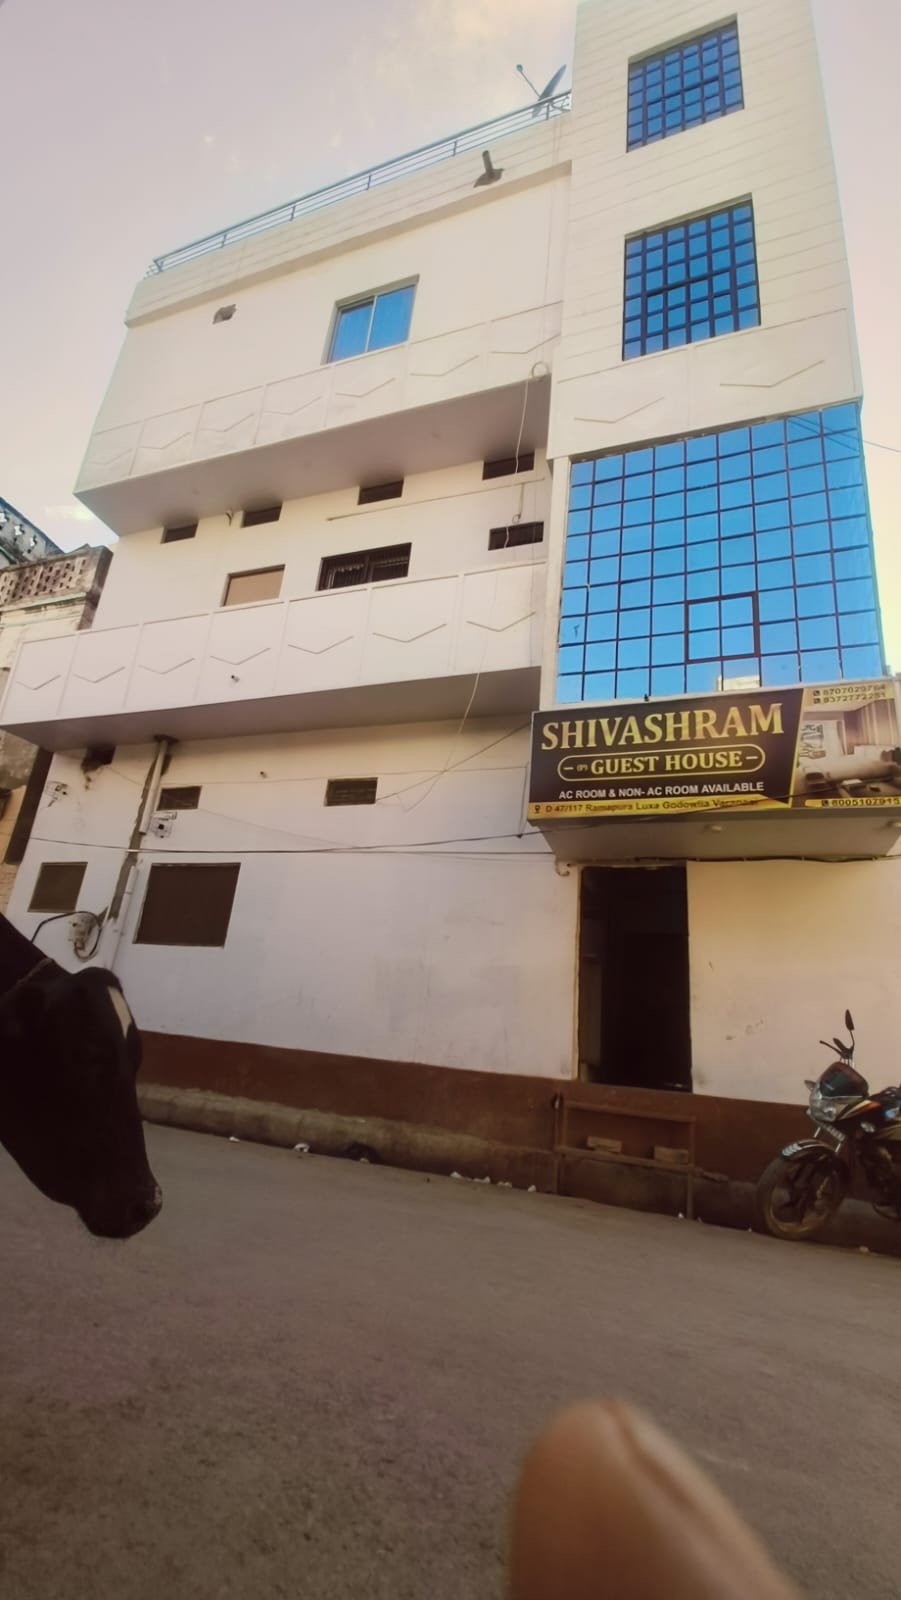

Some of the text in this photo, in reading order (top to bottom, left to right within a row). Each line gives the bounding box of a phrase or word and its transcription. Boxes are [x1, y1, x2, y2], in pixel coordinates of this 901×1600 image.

[541, 703, 784, 750] SHIVASHRAM
[591, 756, 659, 775] GUEST
[665, 750, 742, 771] HOUSE
[559, 791, 574, 800] AC
[576, 789, 606, 799] ROOM
[608, 788, 616, 797] &
[647, 786, 662, 796] AC
[665, 784, 699, 795] ROOM
[701, 781, 764, 793] AVAILABLE
[636, 800, 660, 810] Luxa
